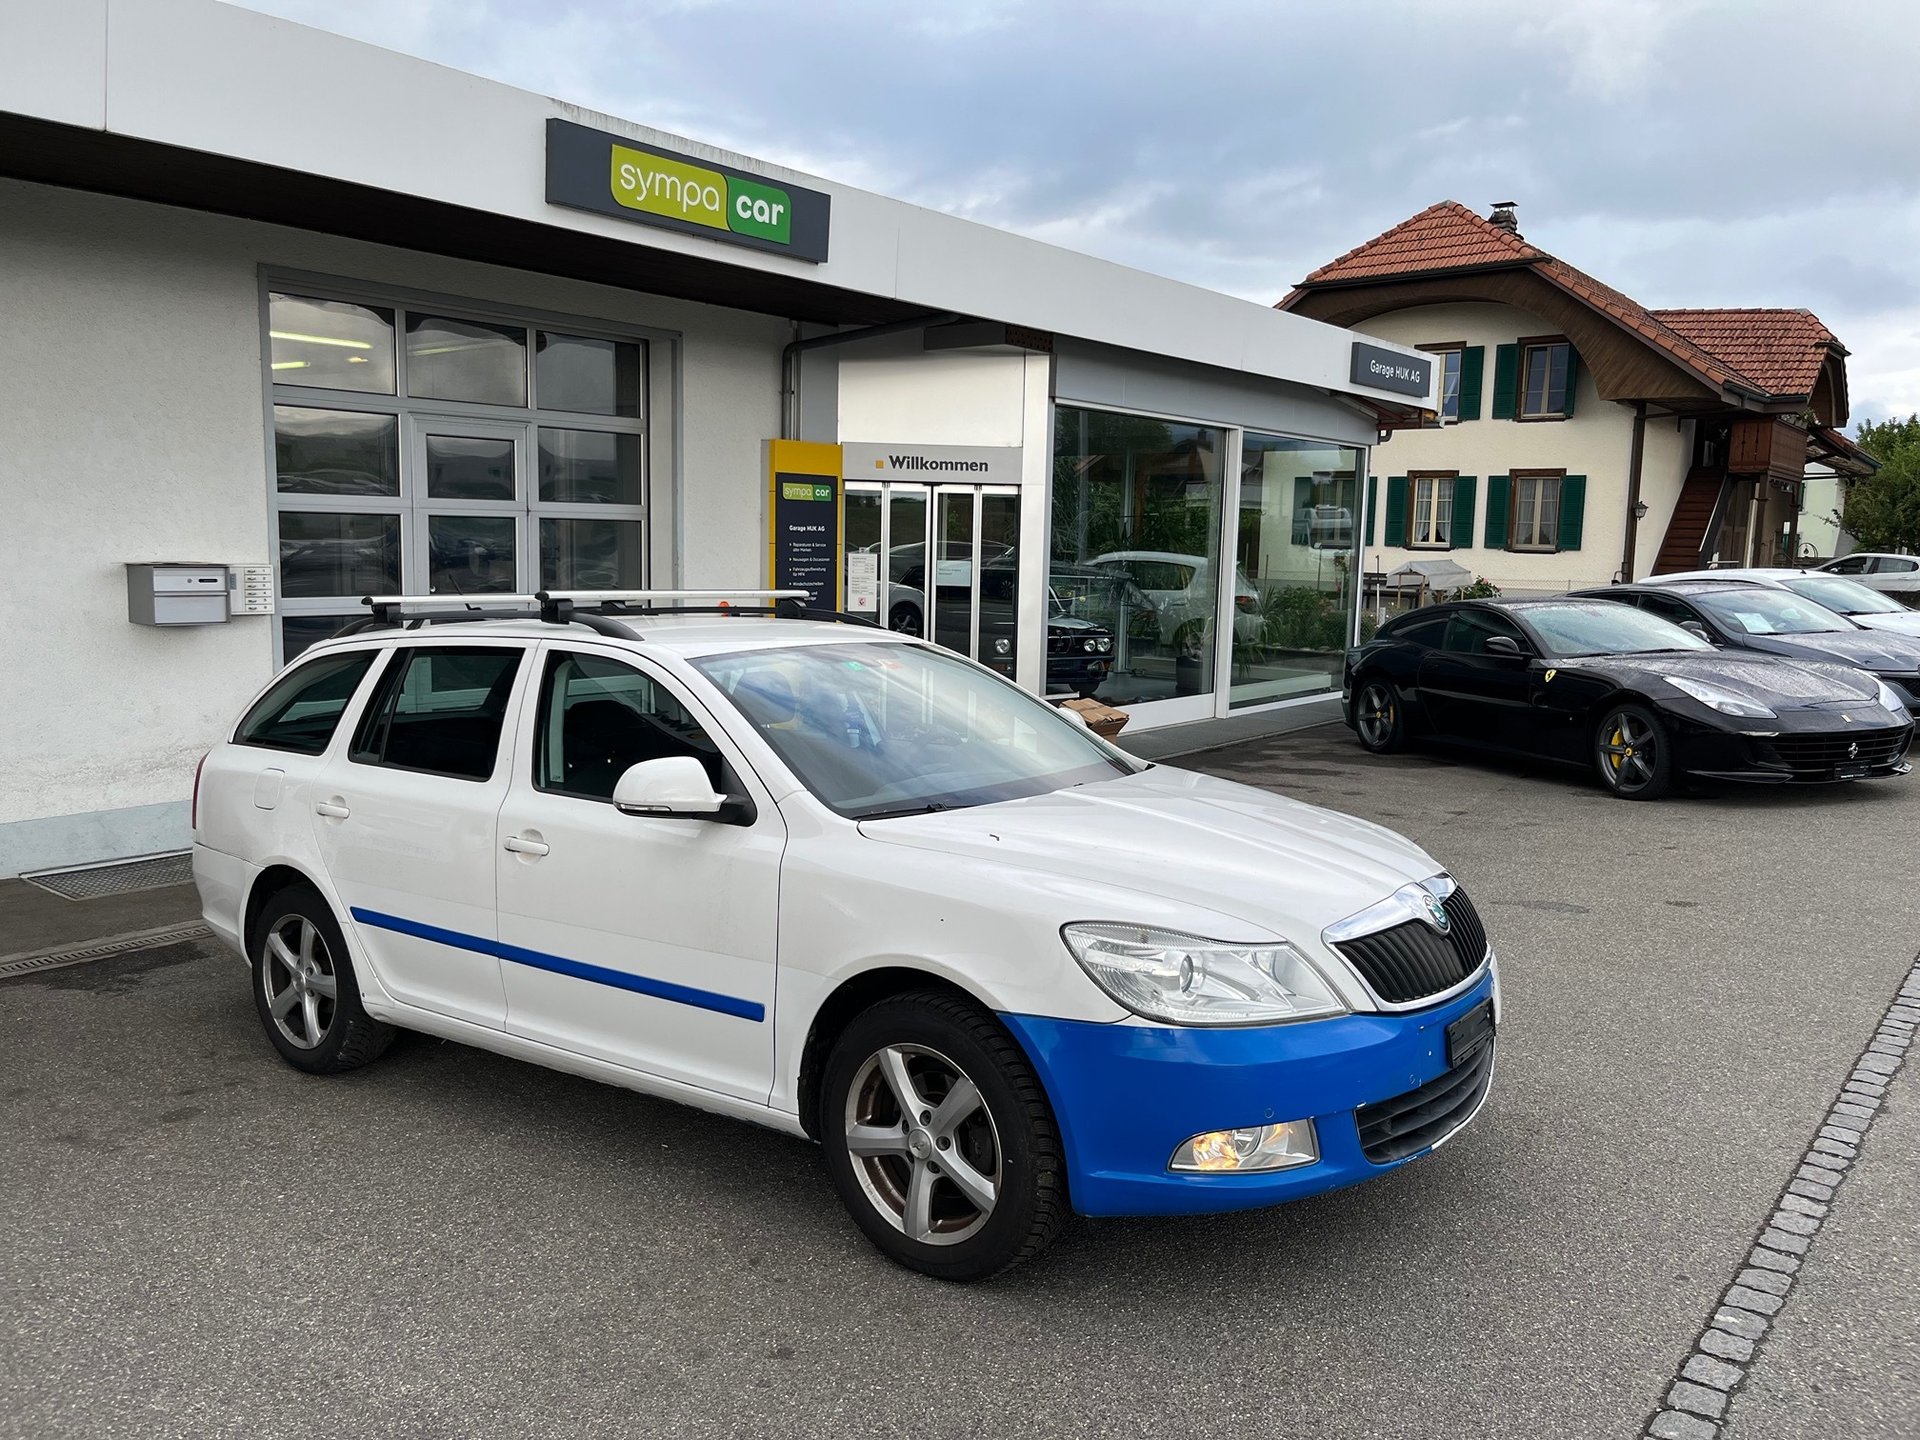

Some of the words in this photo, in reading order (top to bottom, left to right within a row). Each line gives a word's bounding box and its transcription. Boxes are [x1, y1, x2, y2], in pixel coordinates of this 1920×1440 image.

[619, 163, 720, 213] sympa
[736, 195, 784, 226] car
[1370, 359, 1394, 379] Garage
[1395, 366, 1410, 381] HUK
[1410, 370, 1420, 383] AG
[889, 455, 989, 472] Willkommen
[785, 487, 812, 498] sympa
[815, 489, 830, 497] car
